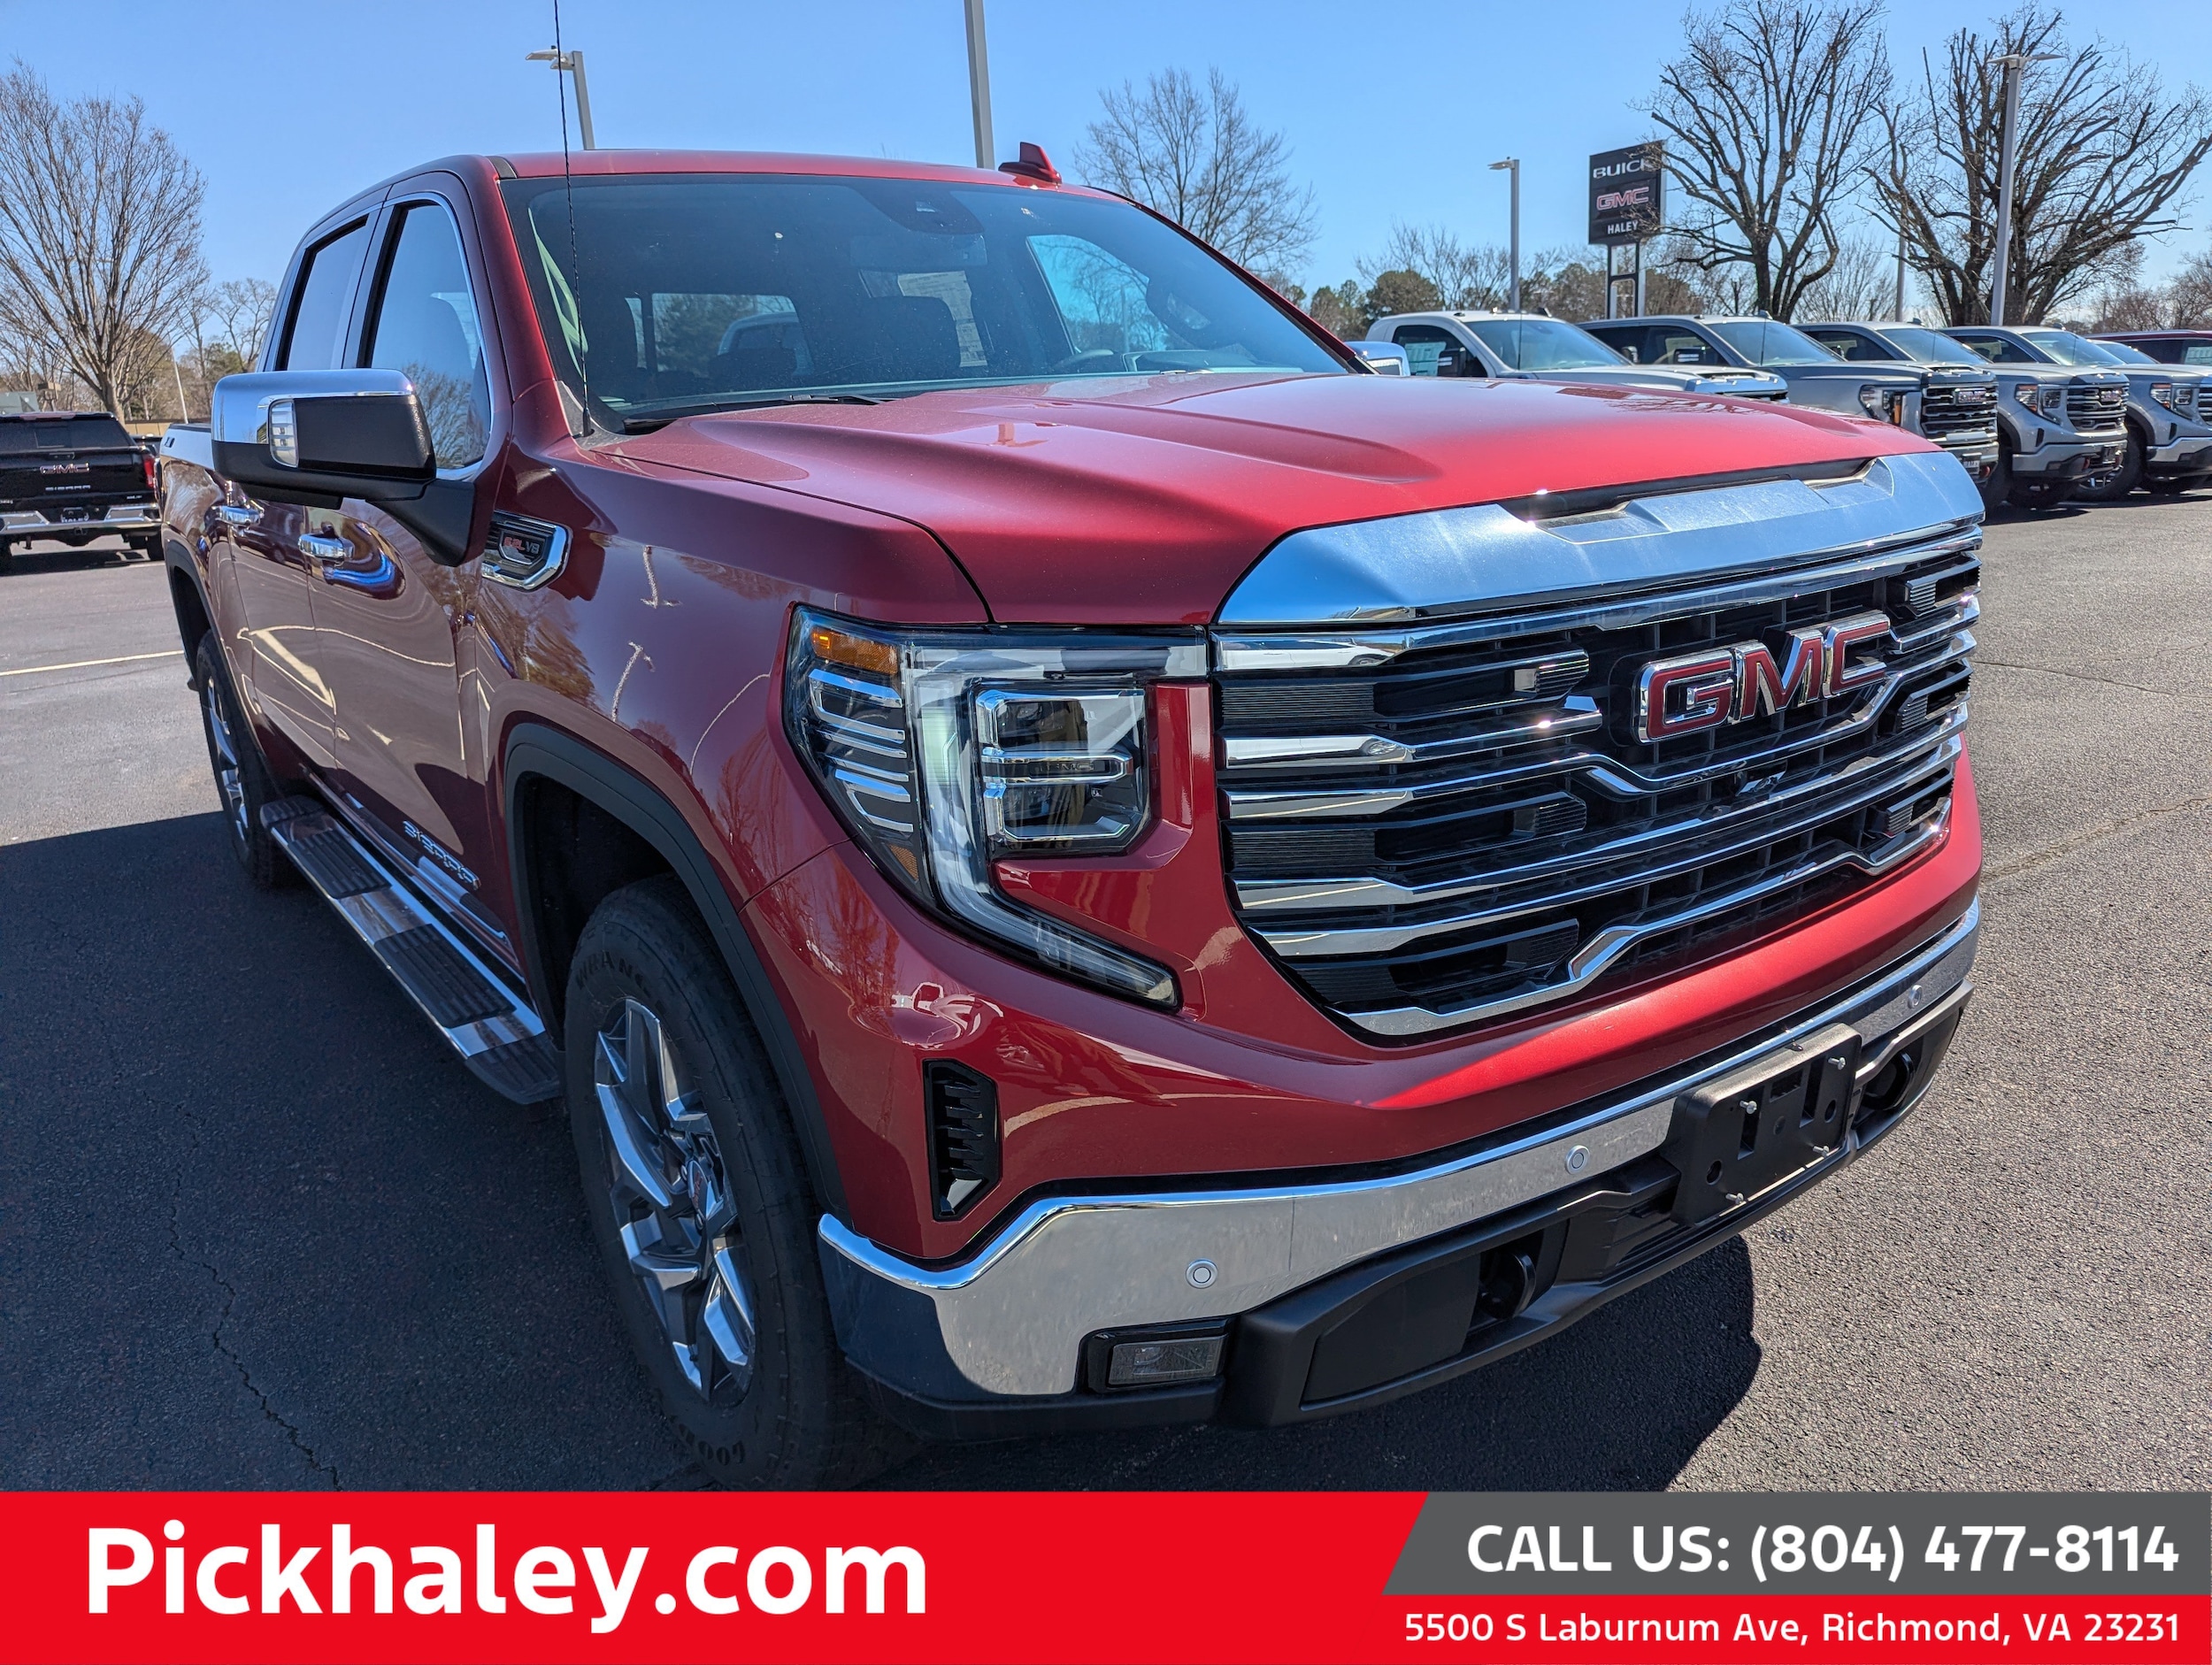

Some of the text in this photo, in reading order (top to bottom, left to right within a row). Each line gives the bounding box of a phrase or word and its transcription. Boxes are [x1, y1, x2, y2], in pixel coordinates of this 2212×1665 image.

[1596, 187, 1649, 211] GMC
[1607, 220, 1639, 234] HALEY
[40, 463, 90, 475] GMC
[1638, 610, 1891, 743] GMC
